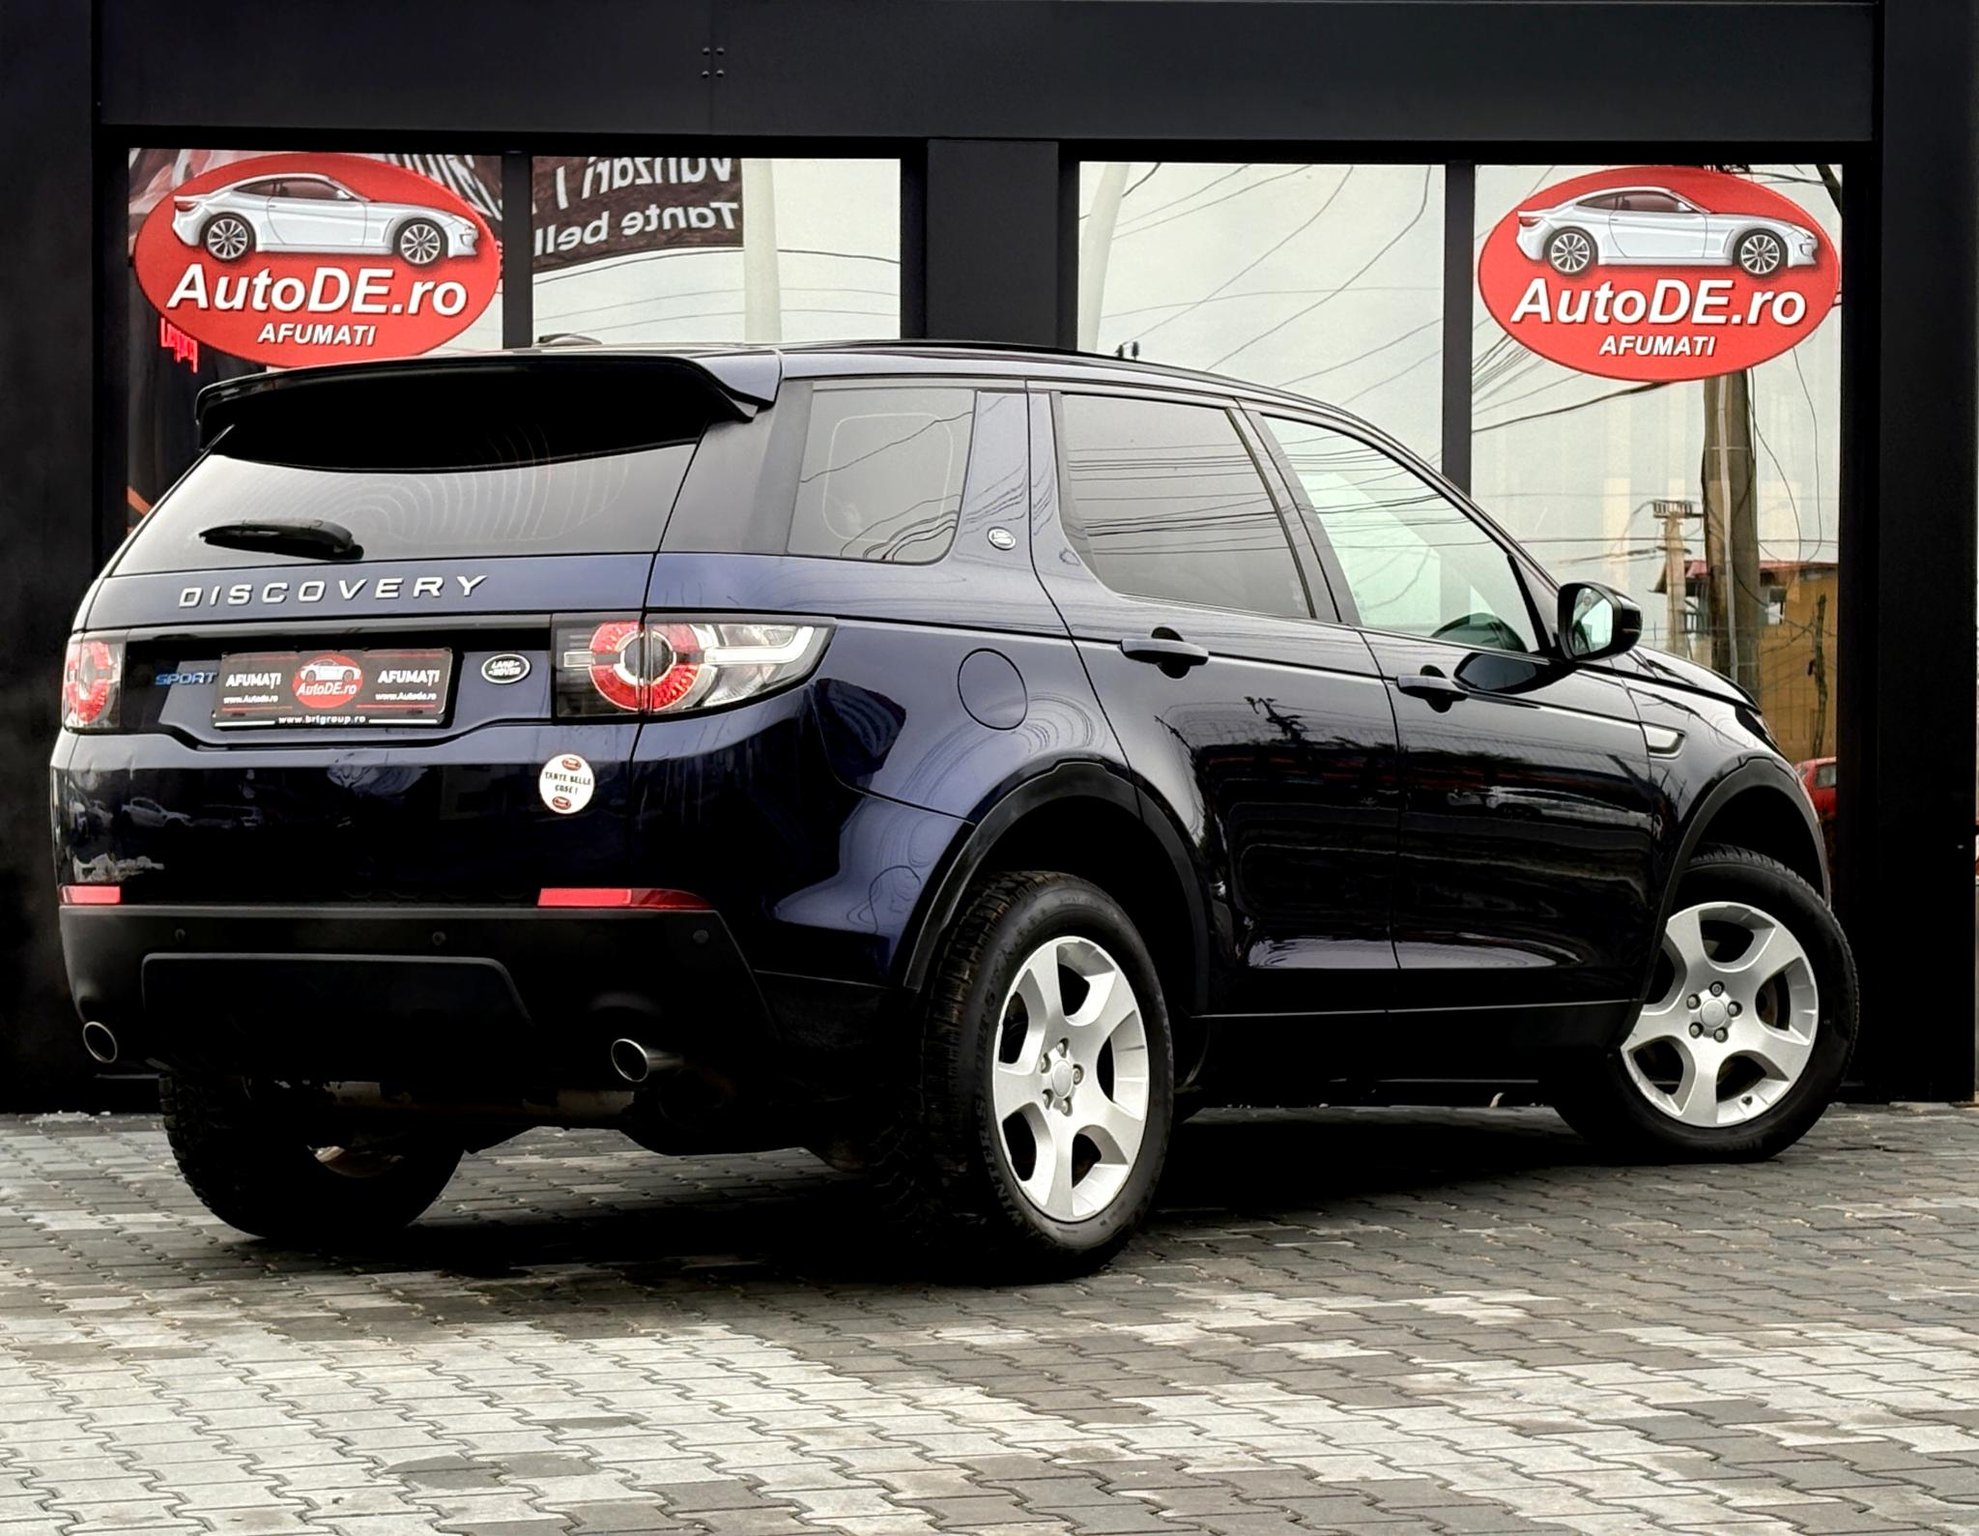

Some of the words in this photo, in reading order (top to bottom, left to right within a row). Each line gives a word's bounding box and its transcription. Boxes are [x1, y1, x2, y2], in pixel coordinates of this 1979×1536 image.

[166, 264, 468, 316] AutoDE.ro
[1510, 277, 1808, 326] AutoDE.ro
[256, 323, 377, 346] AFUMATI
[1598, 336, 1717, 357] AFUMATI
[178, 574, 488, 608] DISCOVERY
[155, 671, 219, 686] SPORT
[296, 682, 357, 697] AutoDE.ro
